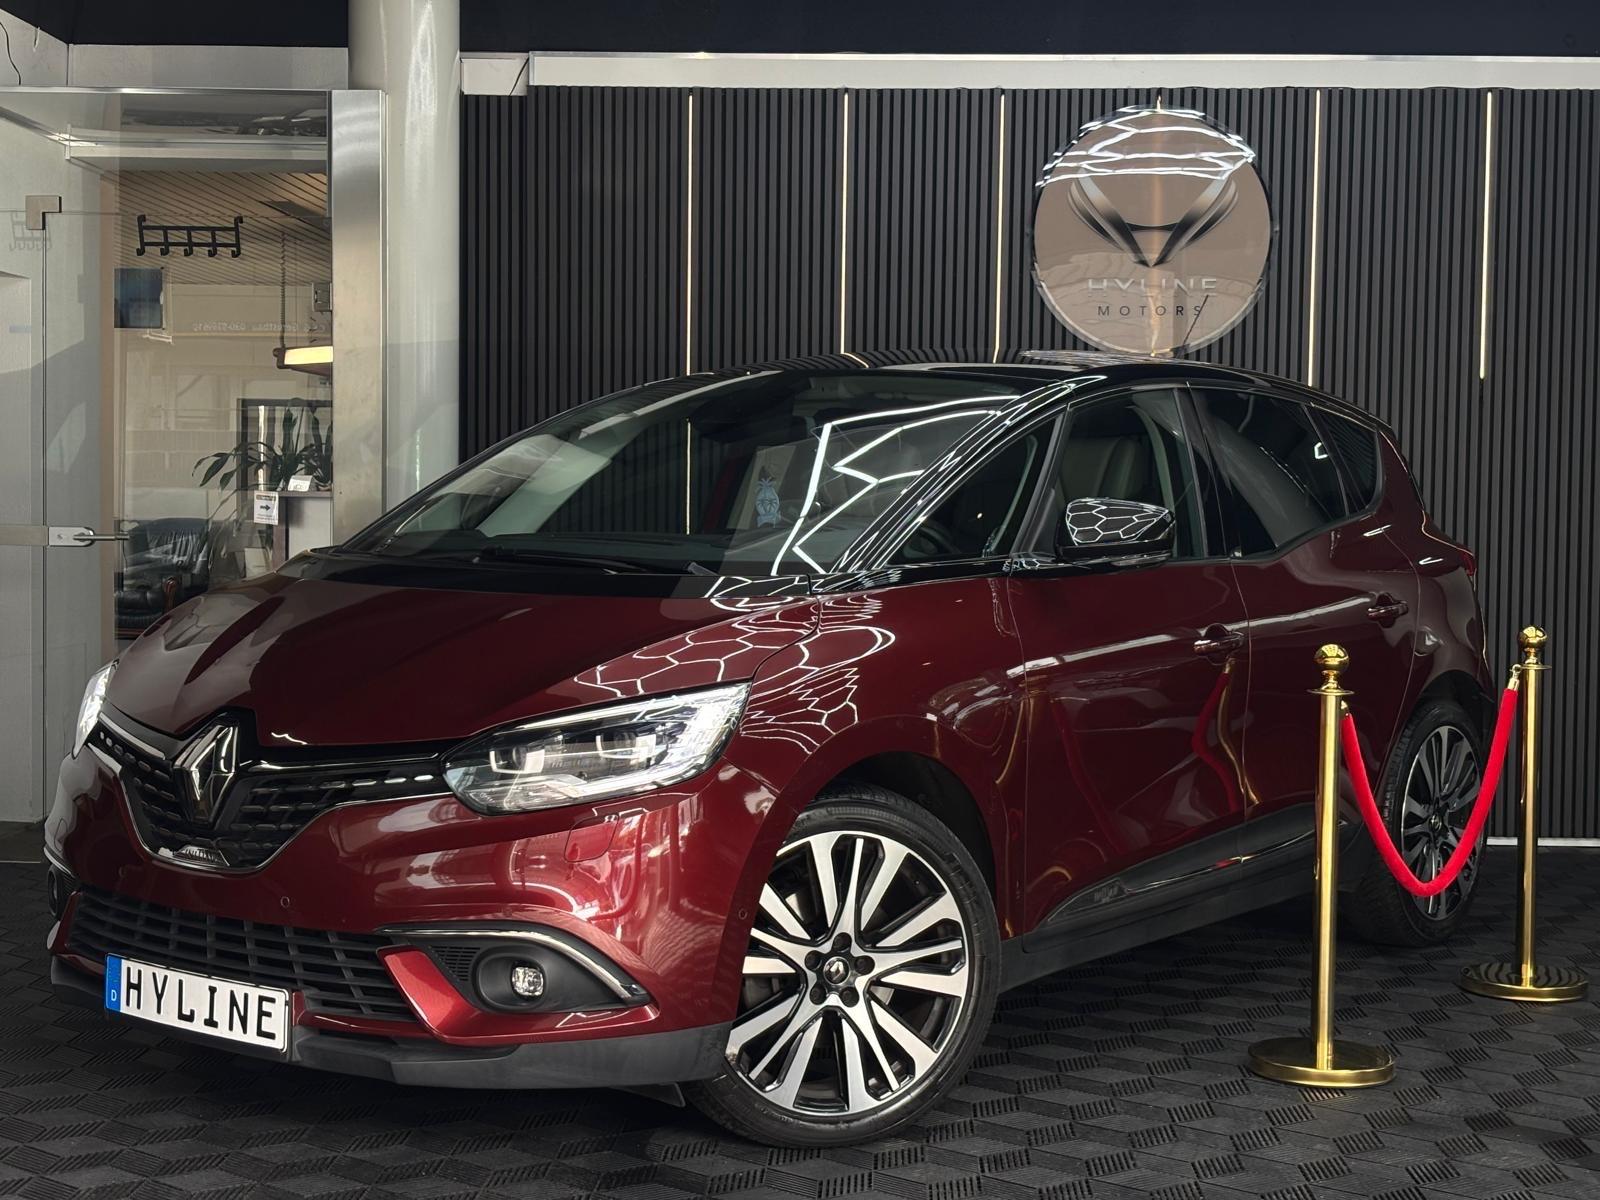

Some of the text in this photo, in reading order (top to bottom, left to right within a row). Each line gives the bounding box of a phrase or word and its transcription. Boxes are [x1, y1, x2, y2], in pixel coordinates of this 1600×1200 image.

[1097, 305, 1202, 317] MOTORS
[111, 966, 276, 1040] D HYLINE
